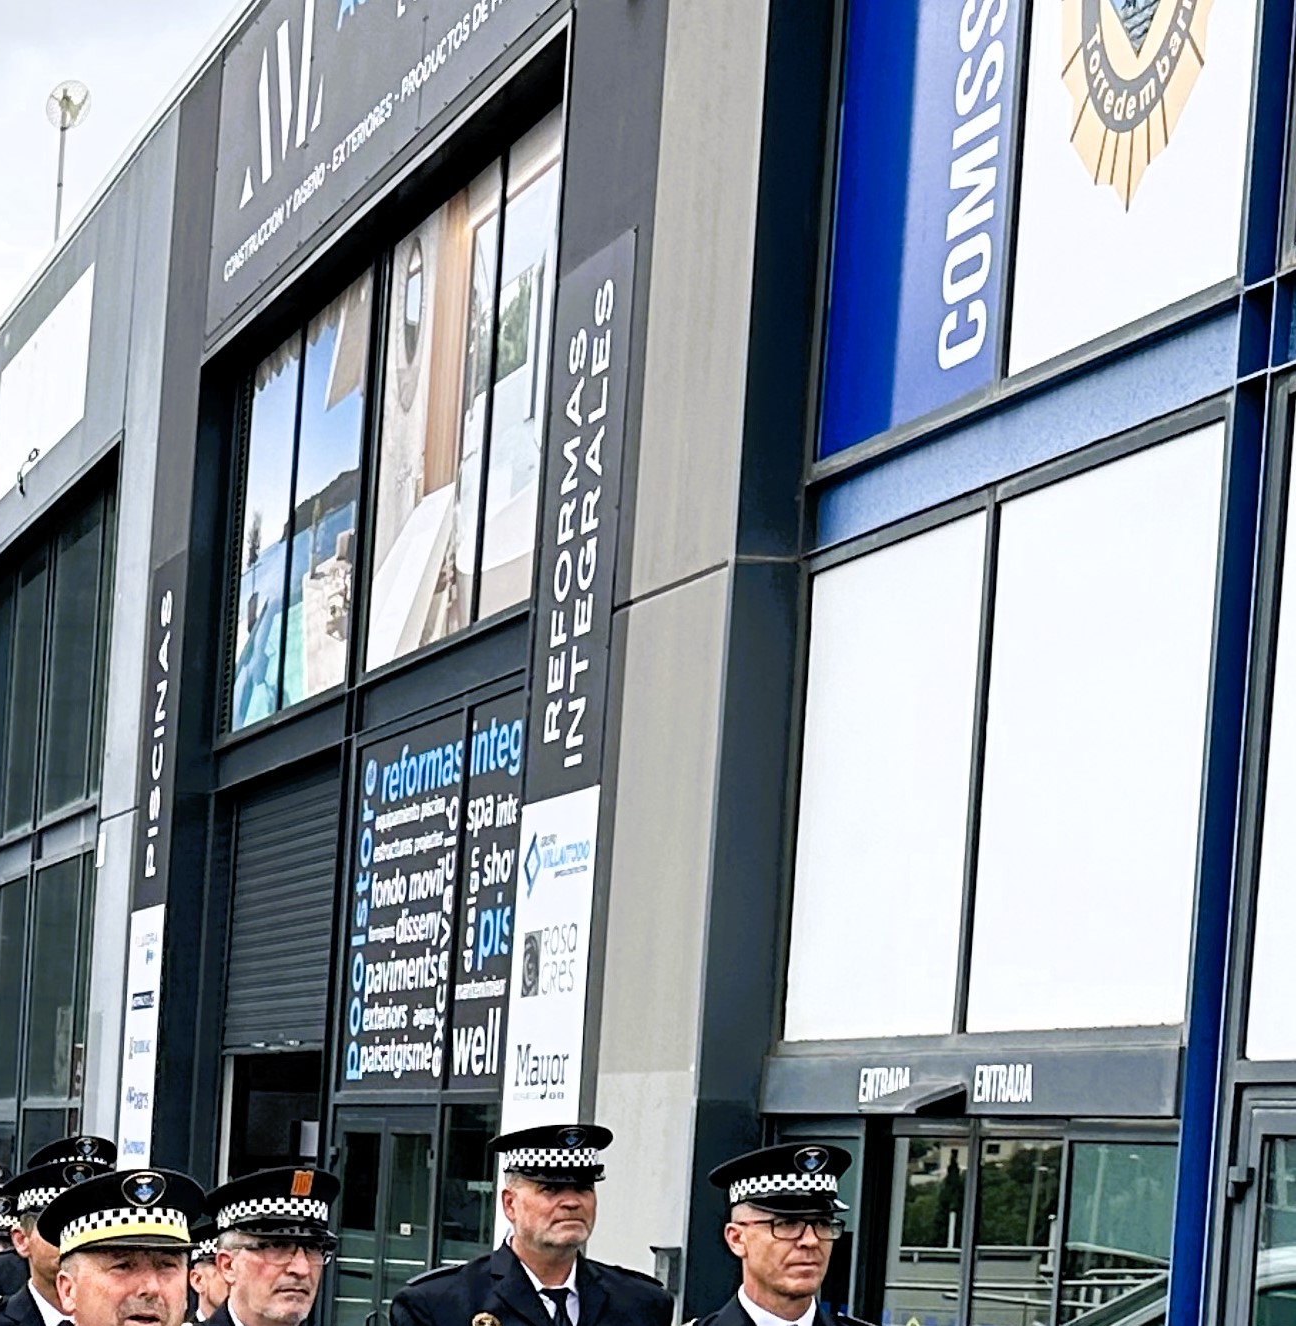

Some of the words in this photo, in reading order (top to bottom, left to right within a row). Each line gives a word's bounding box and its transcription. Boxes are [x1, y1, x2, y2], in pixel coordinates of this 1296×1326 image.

[1087, 0, 1193, 121] Torredembar
[331, 92, 393, 173] EXTERIORES
[400, 19, 471, 103] PRODUCTOS
[544, 328, 587, 744] REFORMAS
[563, 279, 614, 768] INTEGRALES
[145, 589, 173, 878] PISCINAS
[381, 739, 464, 805] reformas
[466, 794, 495, 838] spa
[371, 867, 408, 908] fondo
[395, 907, 443, 947] disseny
[363, 948, 439, 1004] paviments
[362, 997, 409, 1032] exteriors
[452, 1007, 502, 1077] well
[359, 1034, 433, 1080] paisatgisme
[514, 1042, 570, 1101] Mayor
[858, 1066, 911, 1104] ENTRADA
[972, 1063, 1034, 1104] ENTRADA
